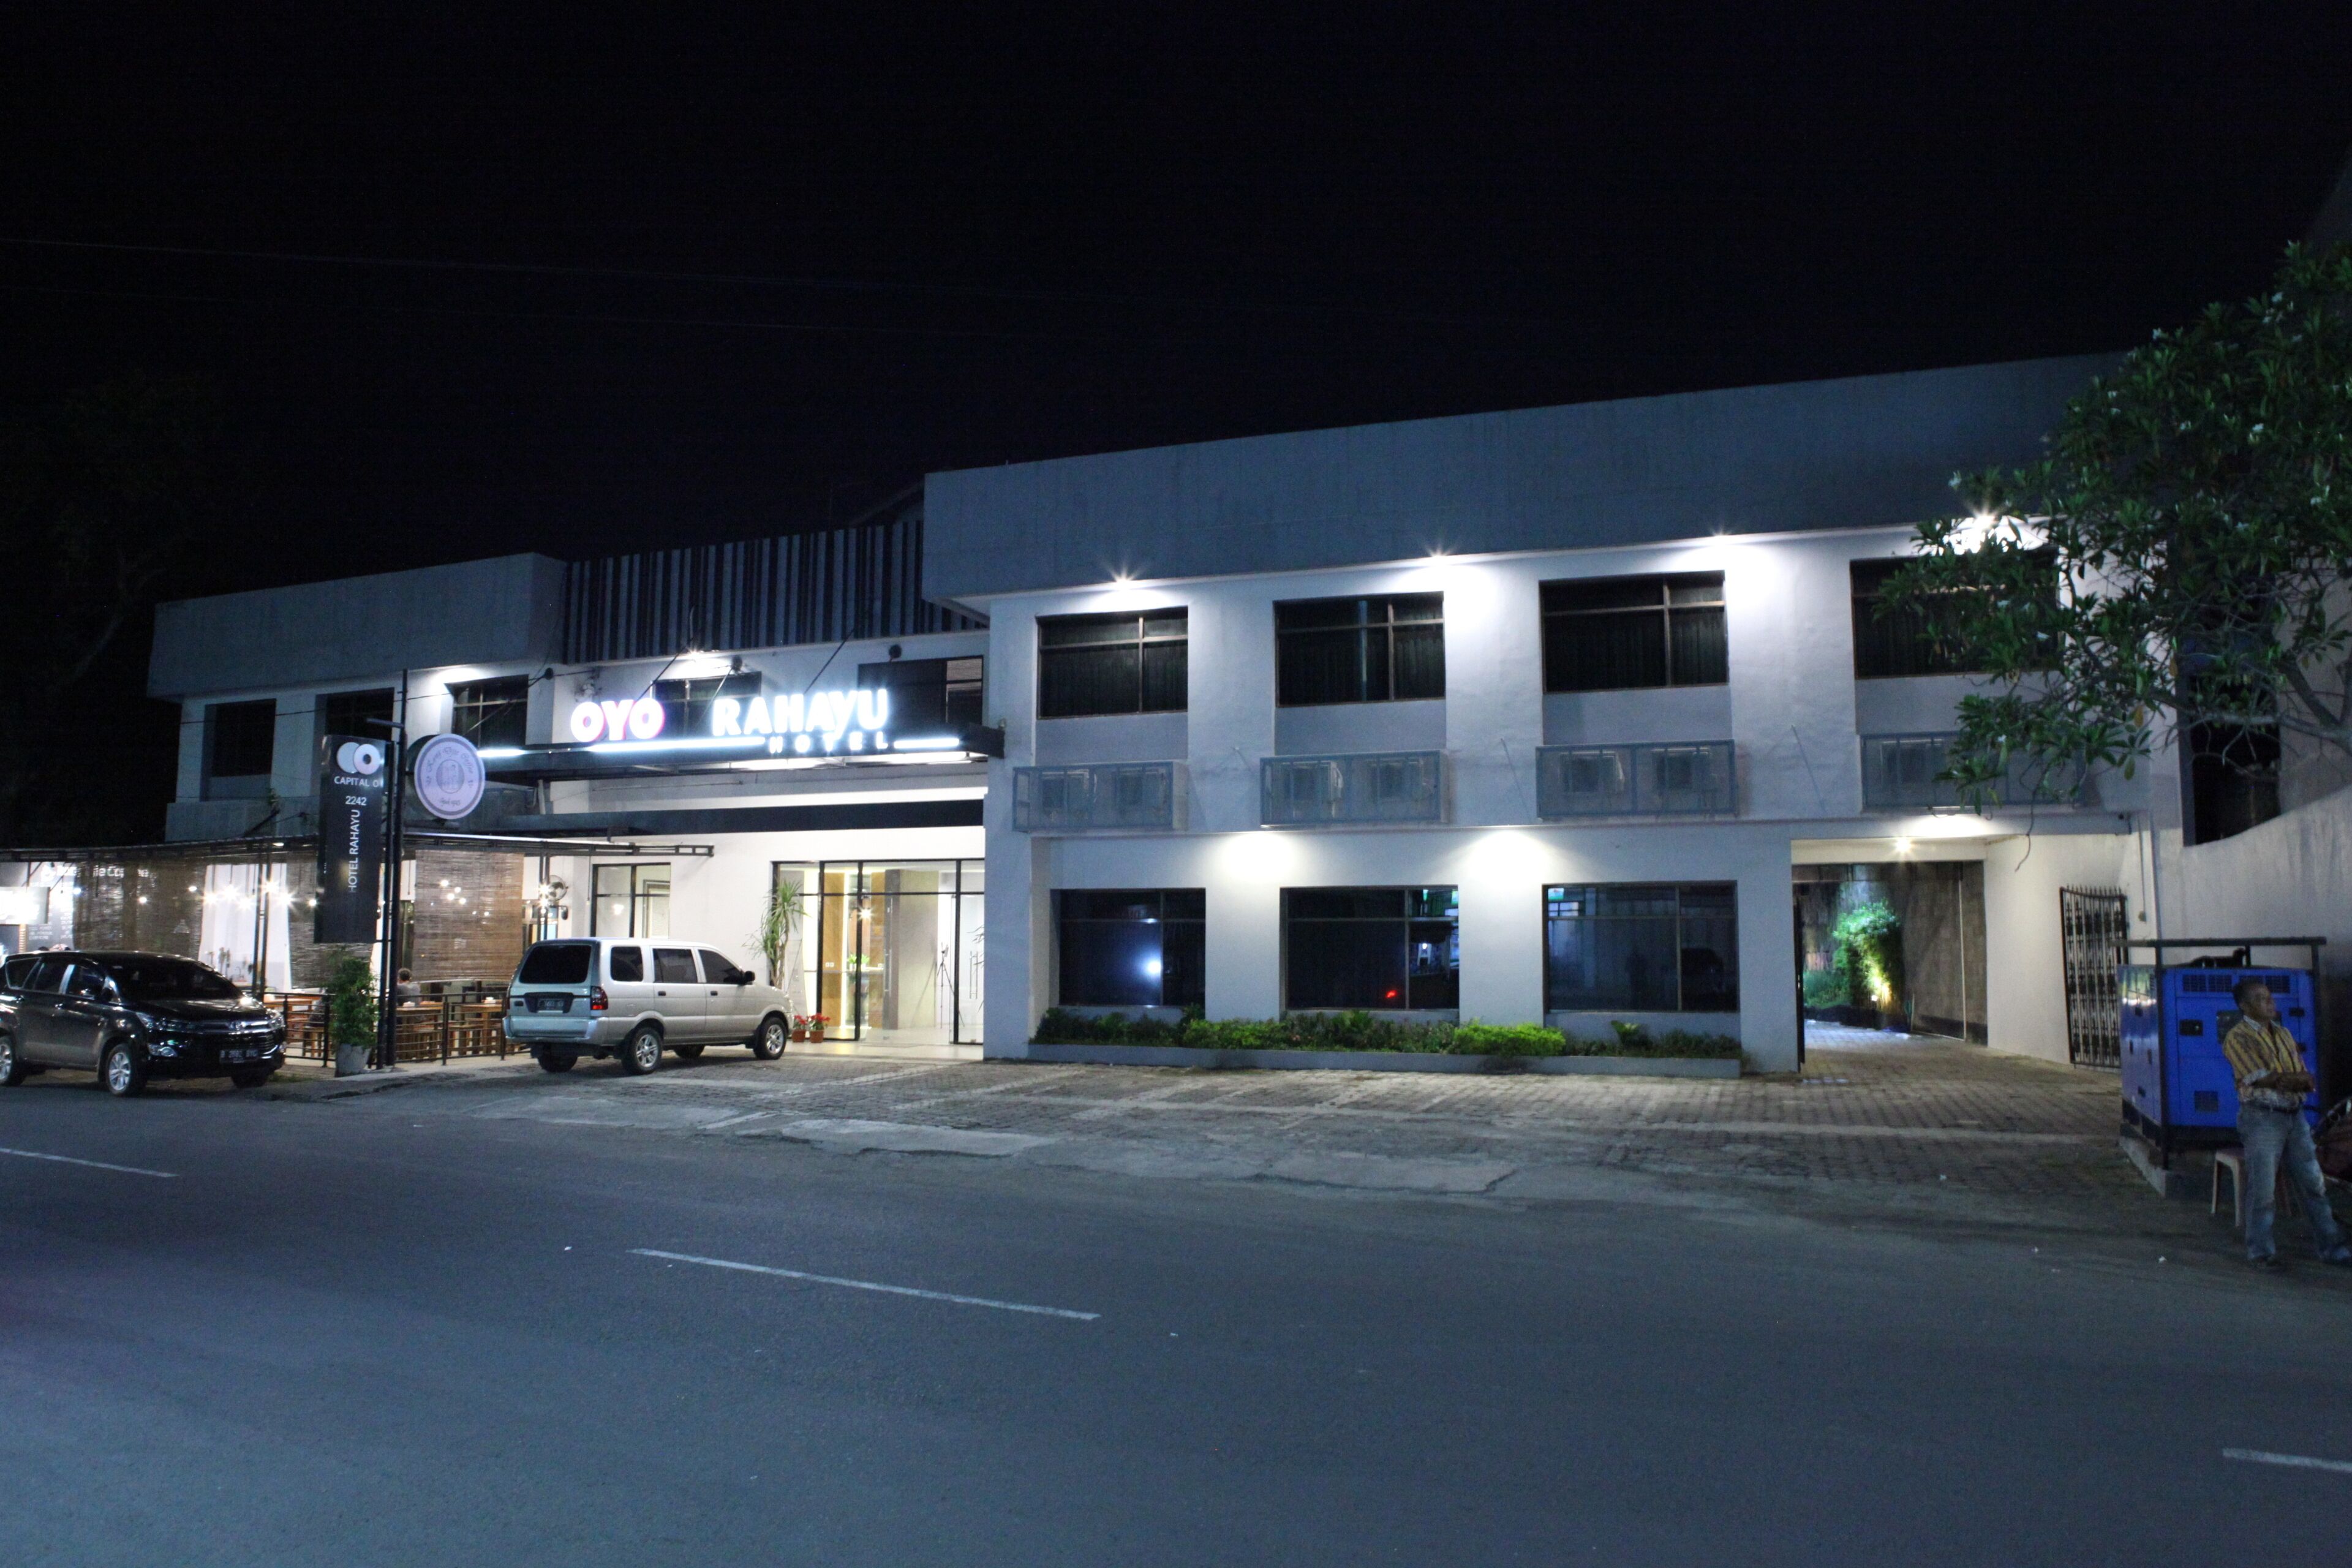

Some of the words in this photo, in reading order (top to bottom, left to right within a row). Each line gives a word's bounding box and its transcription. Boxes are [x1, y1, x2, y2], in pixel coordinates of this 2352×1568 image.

[570, 698, 665, 742] OYO
[711, 688, 888, 739] RAHAYU
[769, 731, 888, 754] HOTEL
[334, 775, 370, 787] CAPITAL
[345, 795, 367, 806] 2242
[349, 809, 361, 855] RAHAYU
[347, 857, 359, 893] HOTEL
